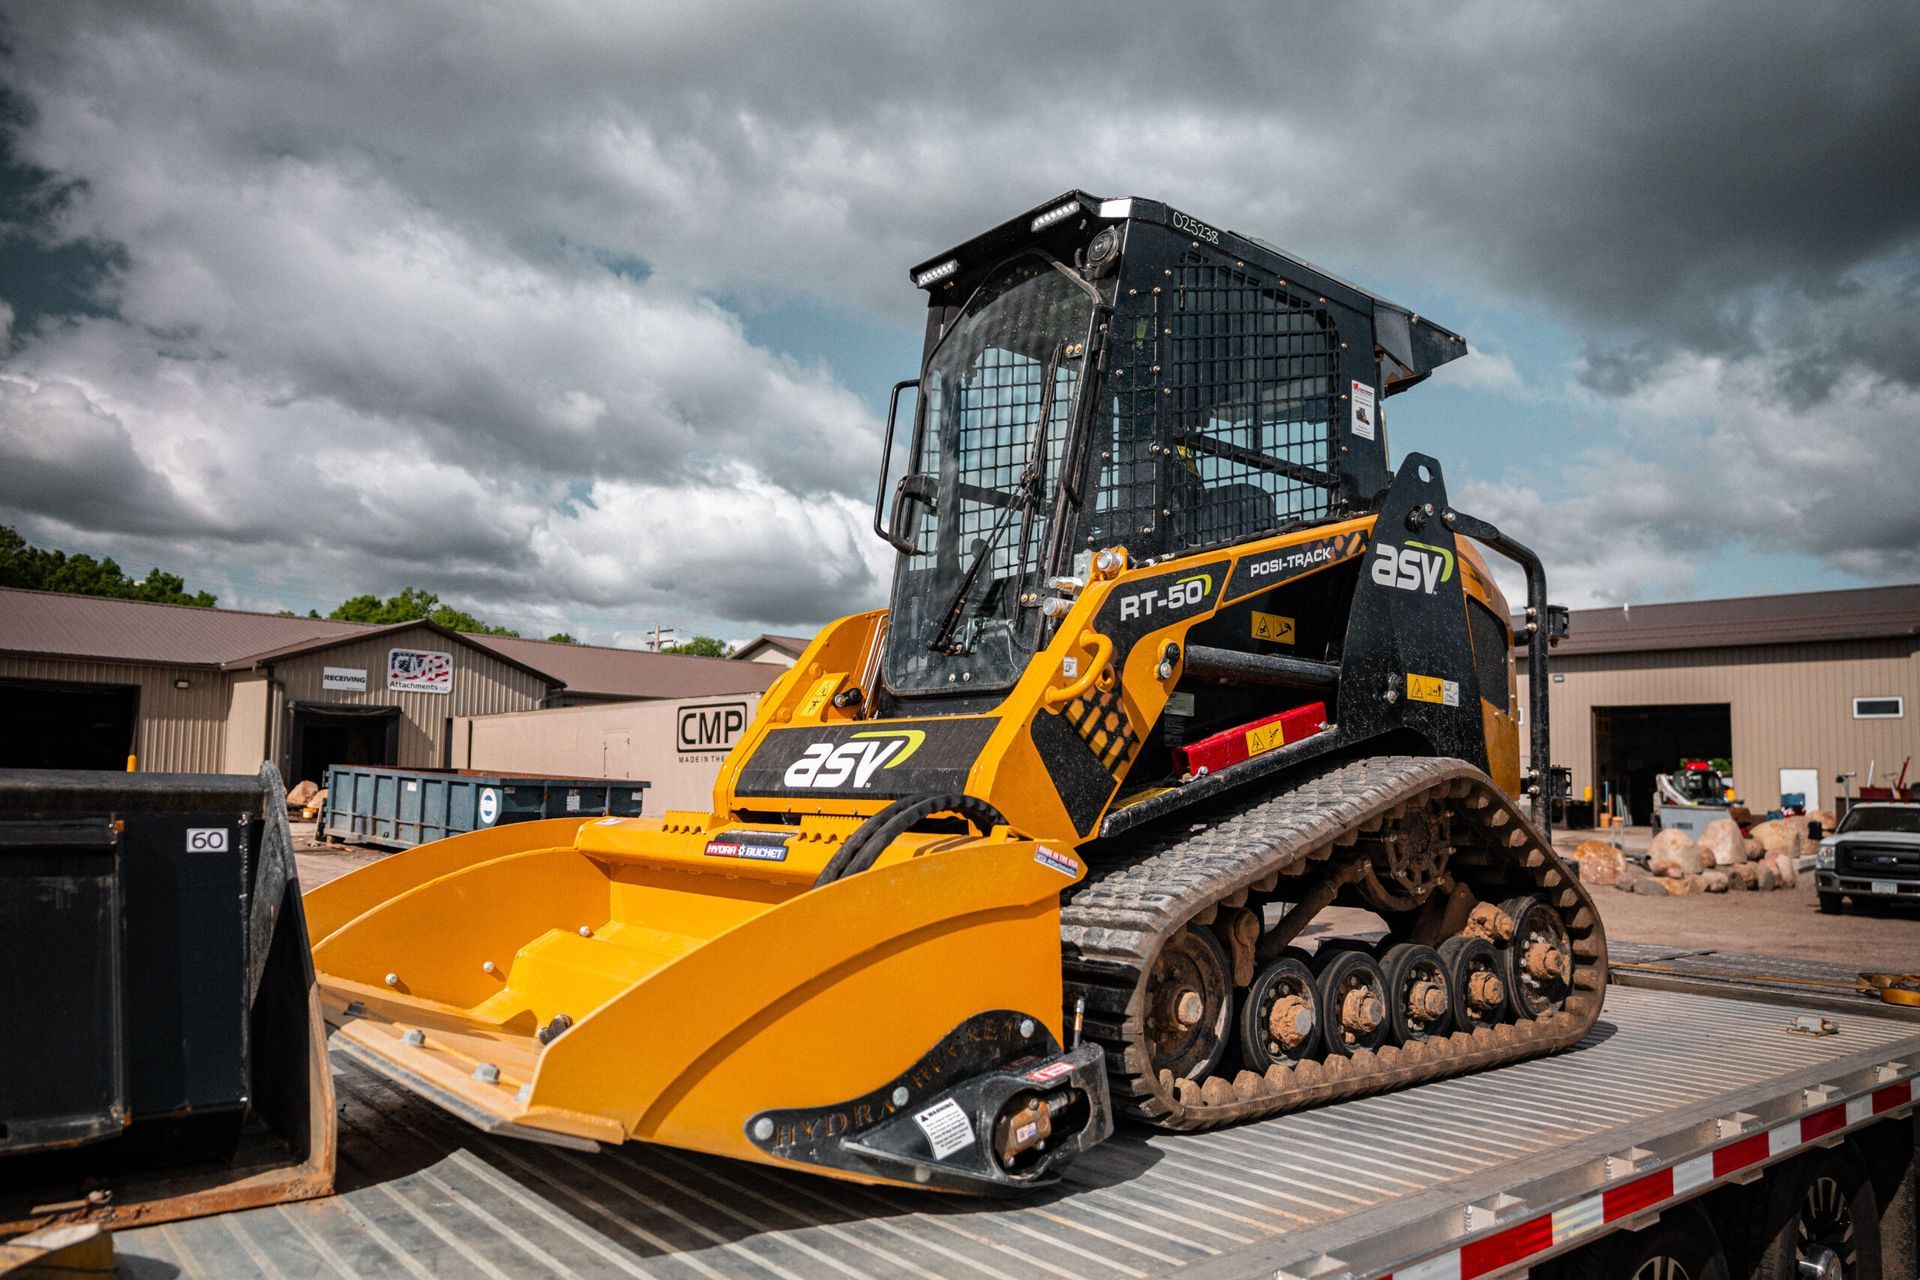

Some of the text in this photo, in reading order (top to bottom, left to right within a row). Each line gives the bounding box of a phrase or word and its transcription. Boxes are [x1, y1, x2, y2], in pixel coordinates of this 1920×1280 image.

[1173, 211, 1219, 245] 025238
[1250, 546, 1332, 578] POSI-TRACK
[1120, 580, 1203, 621] RT-50
[324, 674, 366, 683] RECEIVING
[393, 654, 448, 681] CMP
[389, 681, 438, 691] Attachments
[681, 710, 743, 745] CMP
[678, 756, 700, 764] MADE
[711, 755, 725, 763] THE
[192, 832, 224, 849] 60
[706, 844, 784, 858] HYDRA BUCKET
[928, 1101, 954, 1117] WARNING
[775, 1099, 896, 1148] HYDRA
